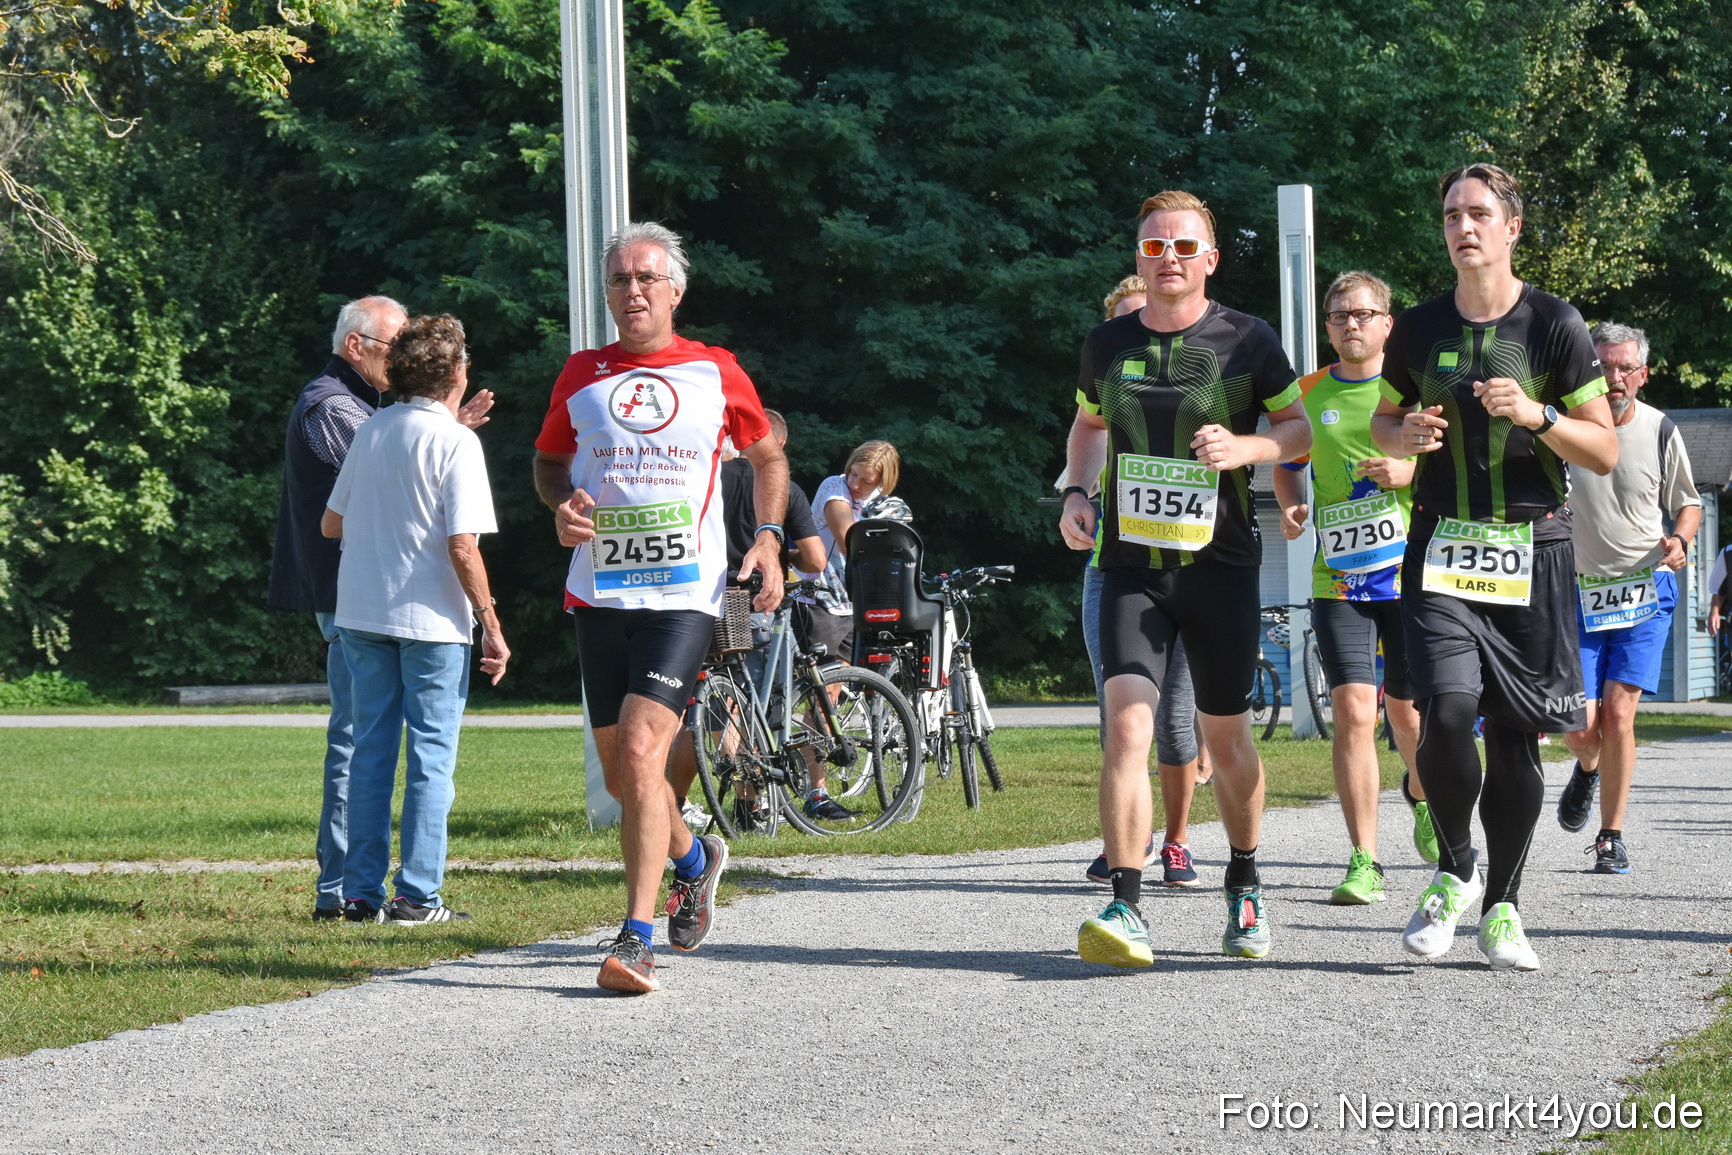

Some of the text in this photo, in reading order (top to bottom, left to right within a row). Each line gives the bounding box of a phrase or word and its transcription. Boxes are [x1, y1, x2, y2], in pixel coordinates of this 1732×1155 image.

[593, 445, 698, 460] LAUFEN MIT HERZ
[613, 462, 635, 470] Heck
[642, 462, 655, 470] Dr.
[657, 462, 687, 472] Röschl
[1127, 461, 1204, 483] BOCK
[1128, 487, 1204, 519] 1354
[1325, 499, 1385, 524] BOCK
[598, 506, 680, 529] BOCK
[1126, 520, 1184, 538] CHRISTIAN
[1329, 519, 1395, 553] 2730
[1443, 521, 1520, 541] BOCK
[602, 533, 686, 566] 2455
[1350, 553, 1379, 565] FRANK
[1440, 544, 1521, 575] 1350
[622, 571, 672, 586] JOSEF
[1455, 578, 1497, 593] LARS
[1589, 583, 1646, 612] 2447
[1593, 607, 1651, 624] REINHARD
[646, 671, 677, 687] JAKO
[1545, 691, 1587, 714] NIKE
